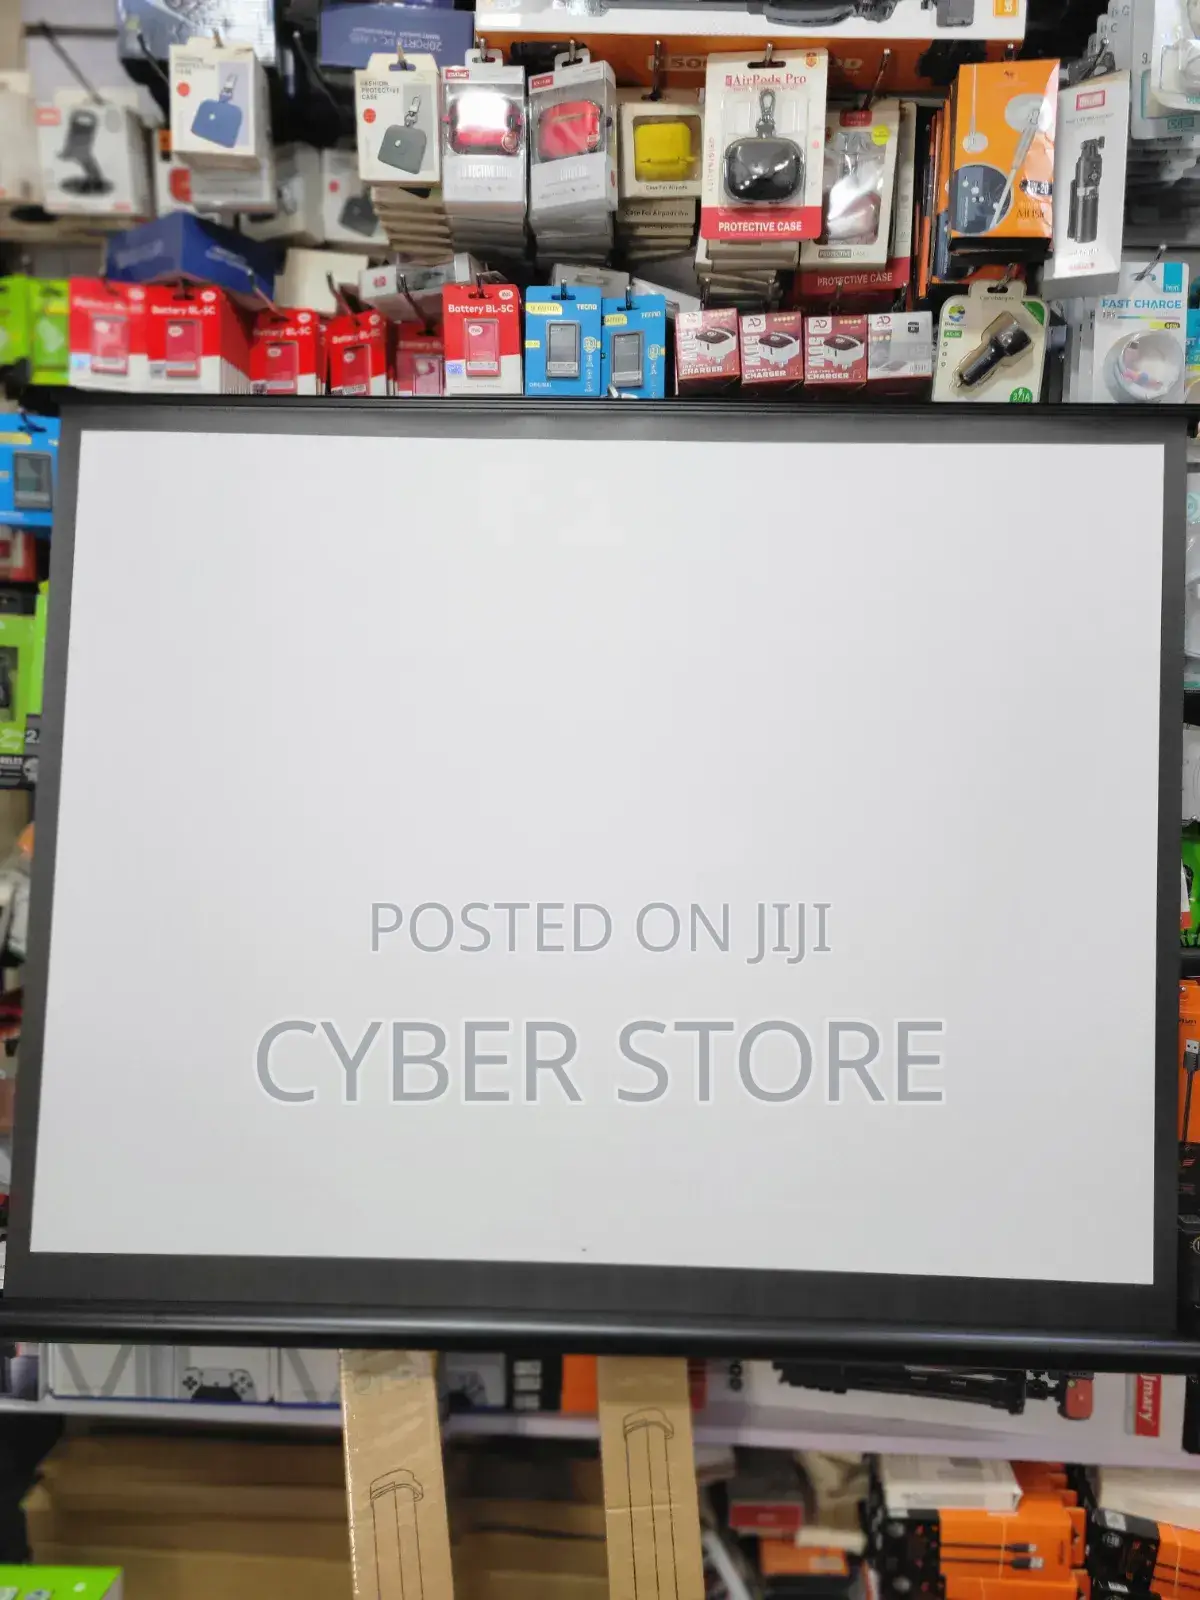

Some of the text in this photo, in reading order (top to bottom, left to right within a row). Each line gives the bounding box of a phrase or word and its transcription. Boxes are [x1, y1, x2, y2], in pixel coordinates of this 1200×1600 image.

[732, 73, 807, 87] AirPods Pro
[718, 221, 802, 232] PROTECTIVE CASE
[817, 272, 893, 287] PROTECTIVE CASE
[448, 304, 514, 314] Battery BL-5C
[576, 303, 598, 311] TECNO
[1102, 299, 1181, 309] FAST CHARGE
[151, 306, 186, 315] Battery
[682, 365, 723, 375] CHARGER
[744, 370, 787, 379] CHARGER
[807, 372, 849, 380] CHARGER
